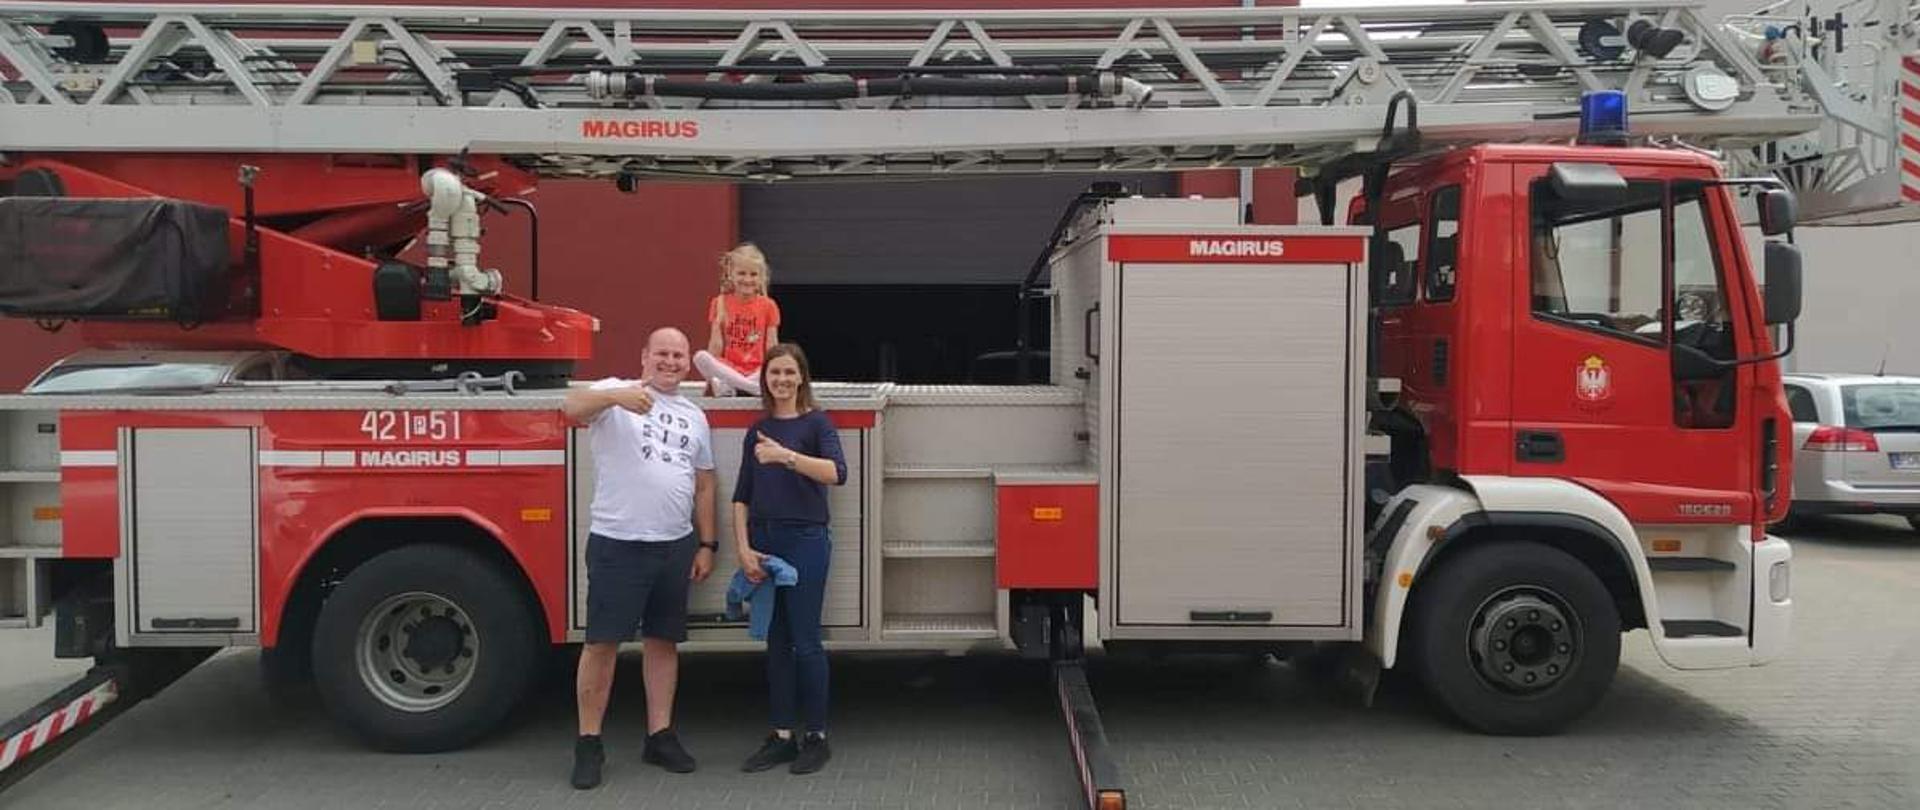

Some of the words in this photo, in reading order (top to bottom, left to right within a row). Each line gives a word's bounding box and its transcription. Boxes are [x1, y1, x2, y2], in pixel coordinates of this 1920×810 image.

[582, 120, 699, 138] MAGIRUS
[1189, 240, 1284, 256] MAGIRUS
[361, 450, 460, 467] MAGIRUS
